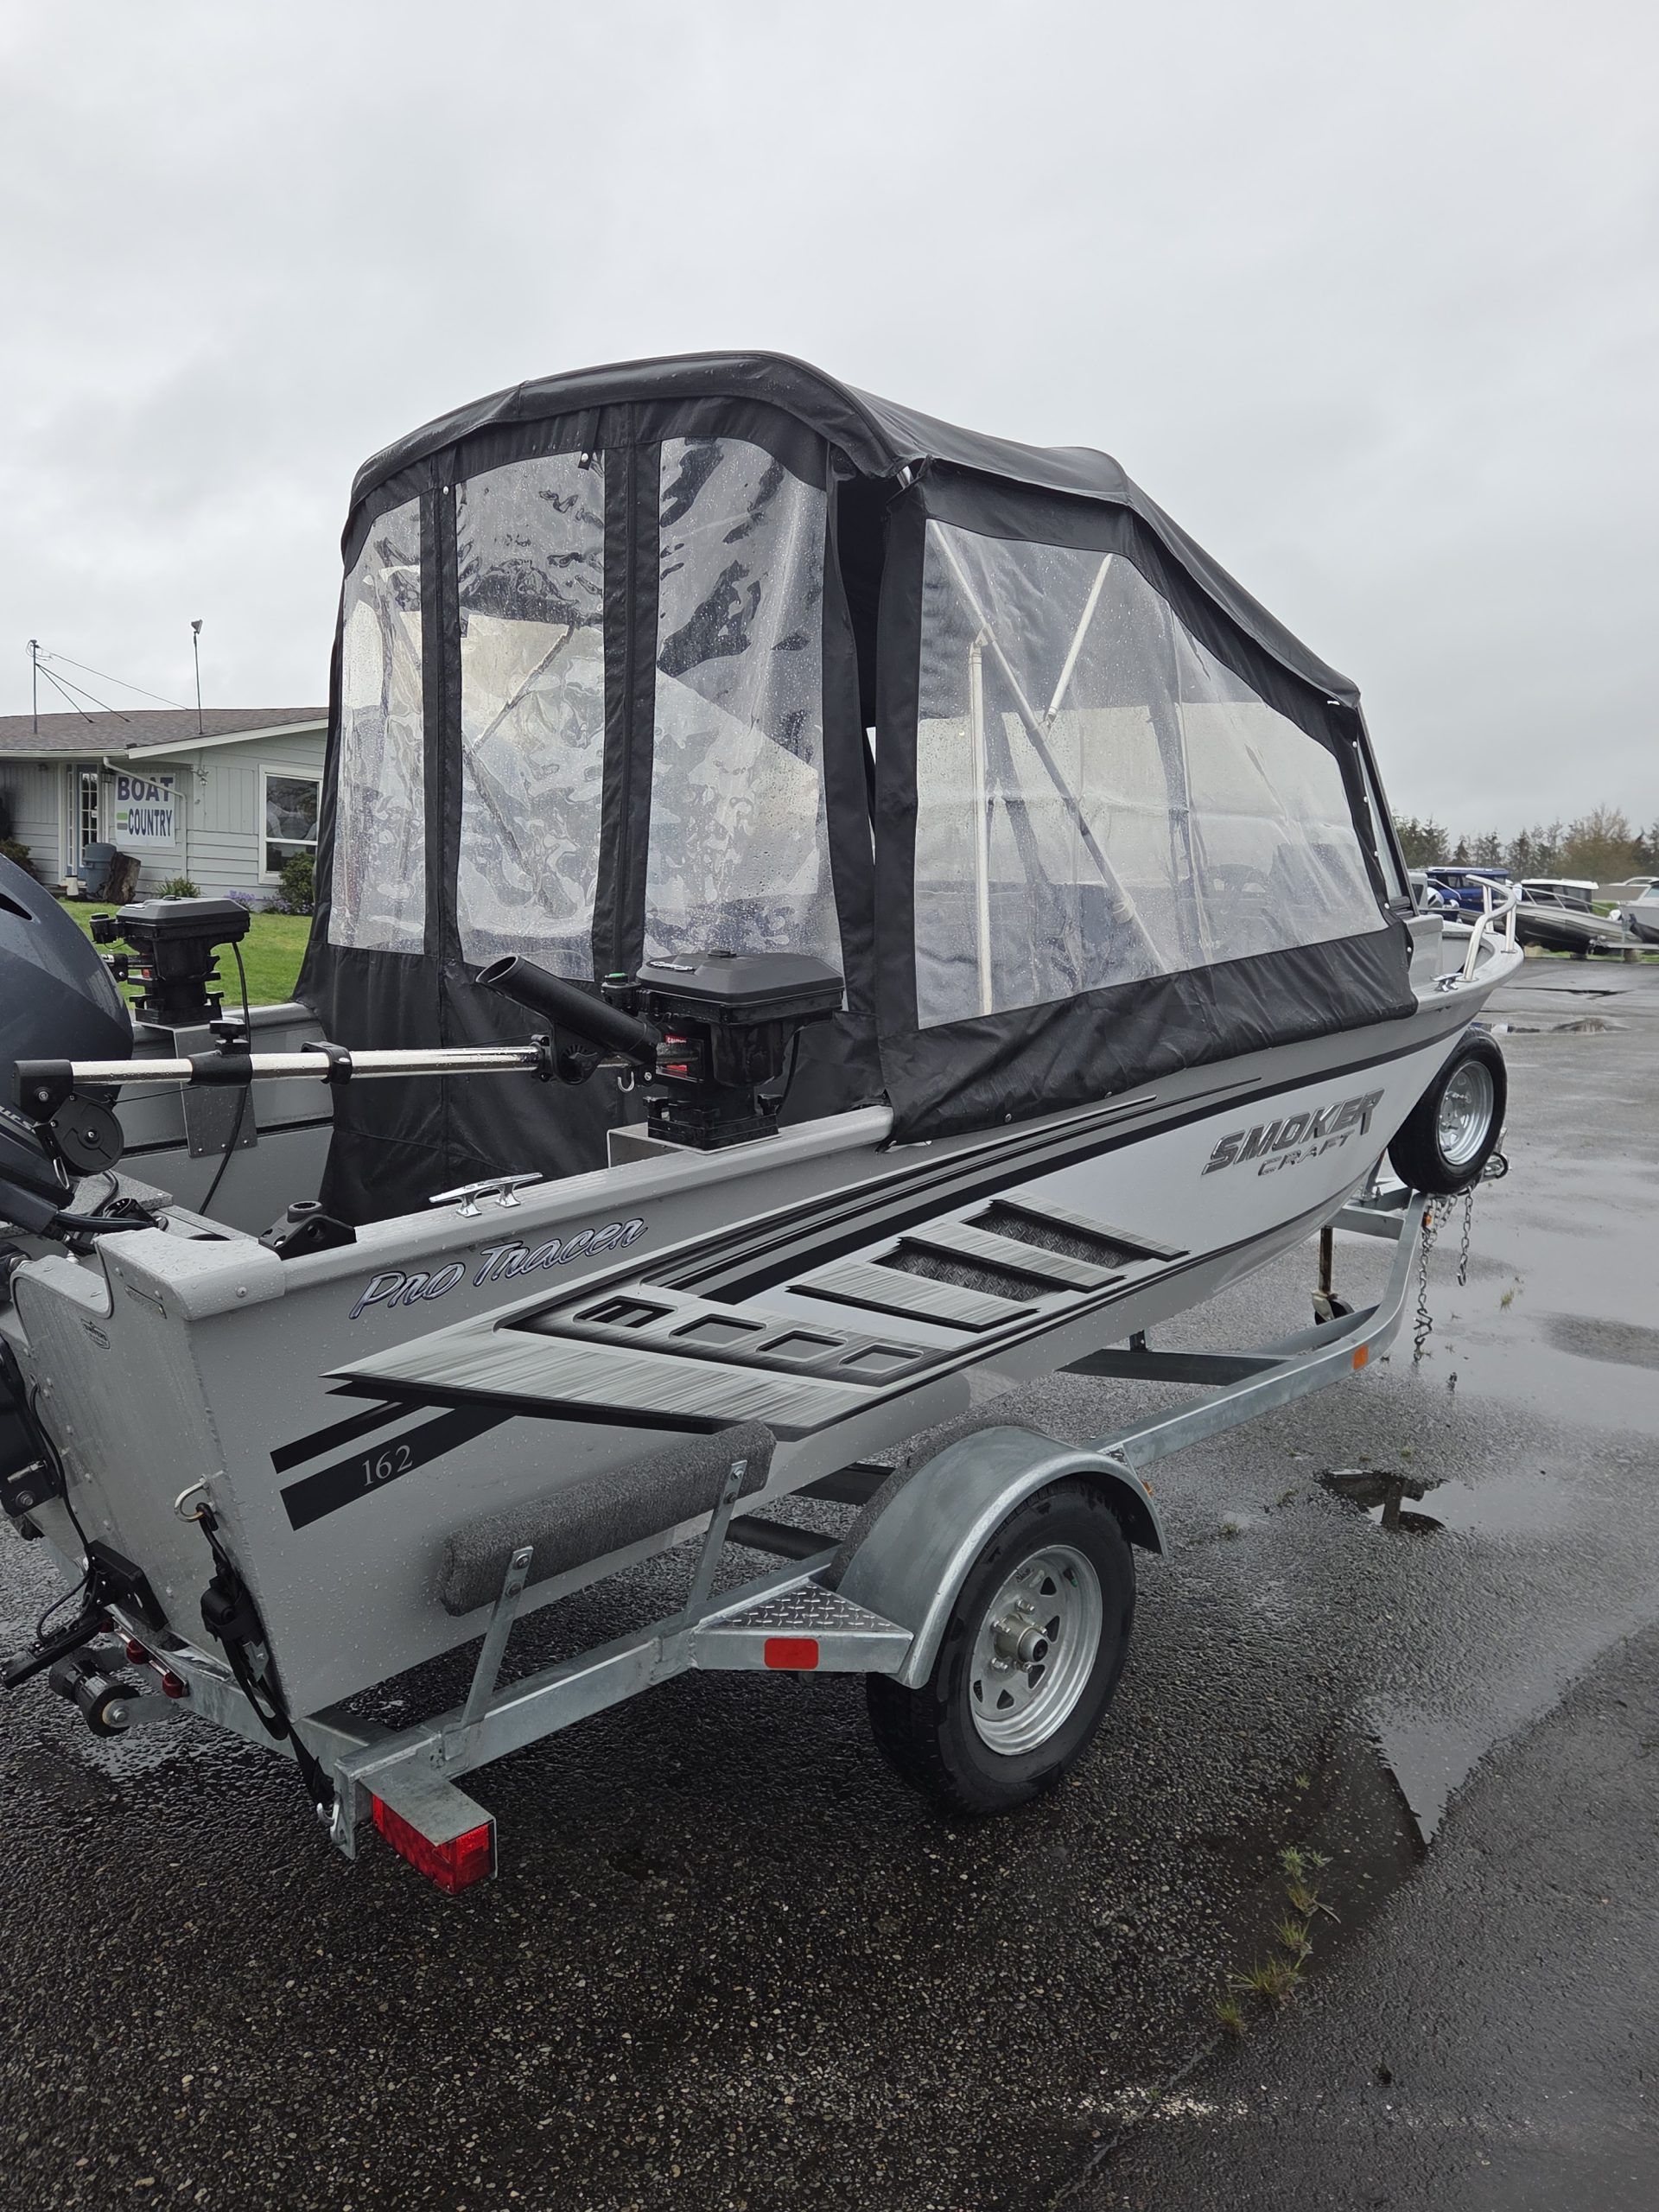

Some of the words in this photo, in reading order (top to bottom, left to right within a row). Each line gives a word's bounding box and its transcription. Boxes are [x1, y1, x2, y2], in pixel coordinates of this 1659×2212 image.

[118, 777, 174, 802] BOAT
[128, 808, 173, 837] COUNTRY
[1201, 1088, 1385, 1176] SMOKER
[1257, 1128, 1356, 1176] CRAFT
[473, 1218, 648, 1287] Tracer
[361, 1445, 413, 1486] 162
